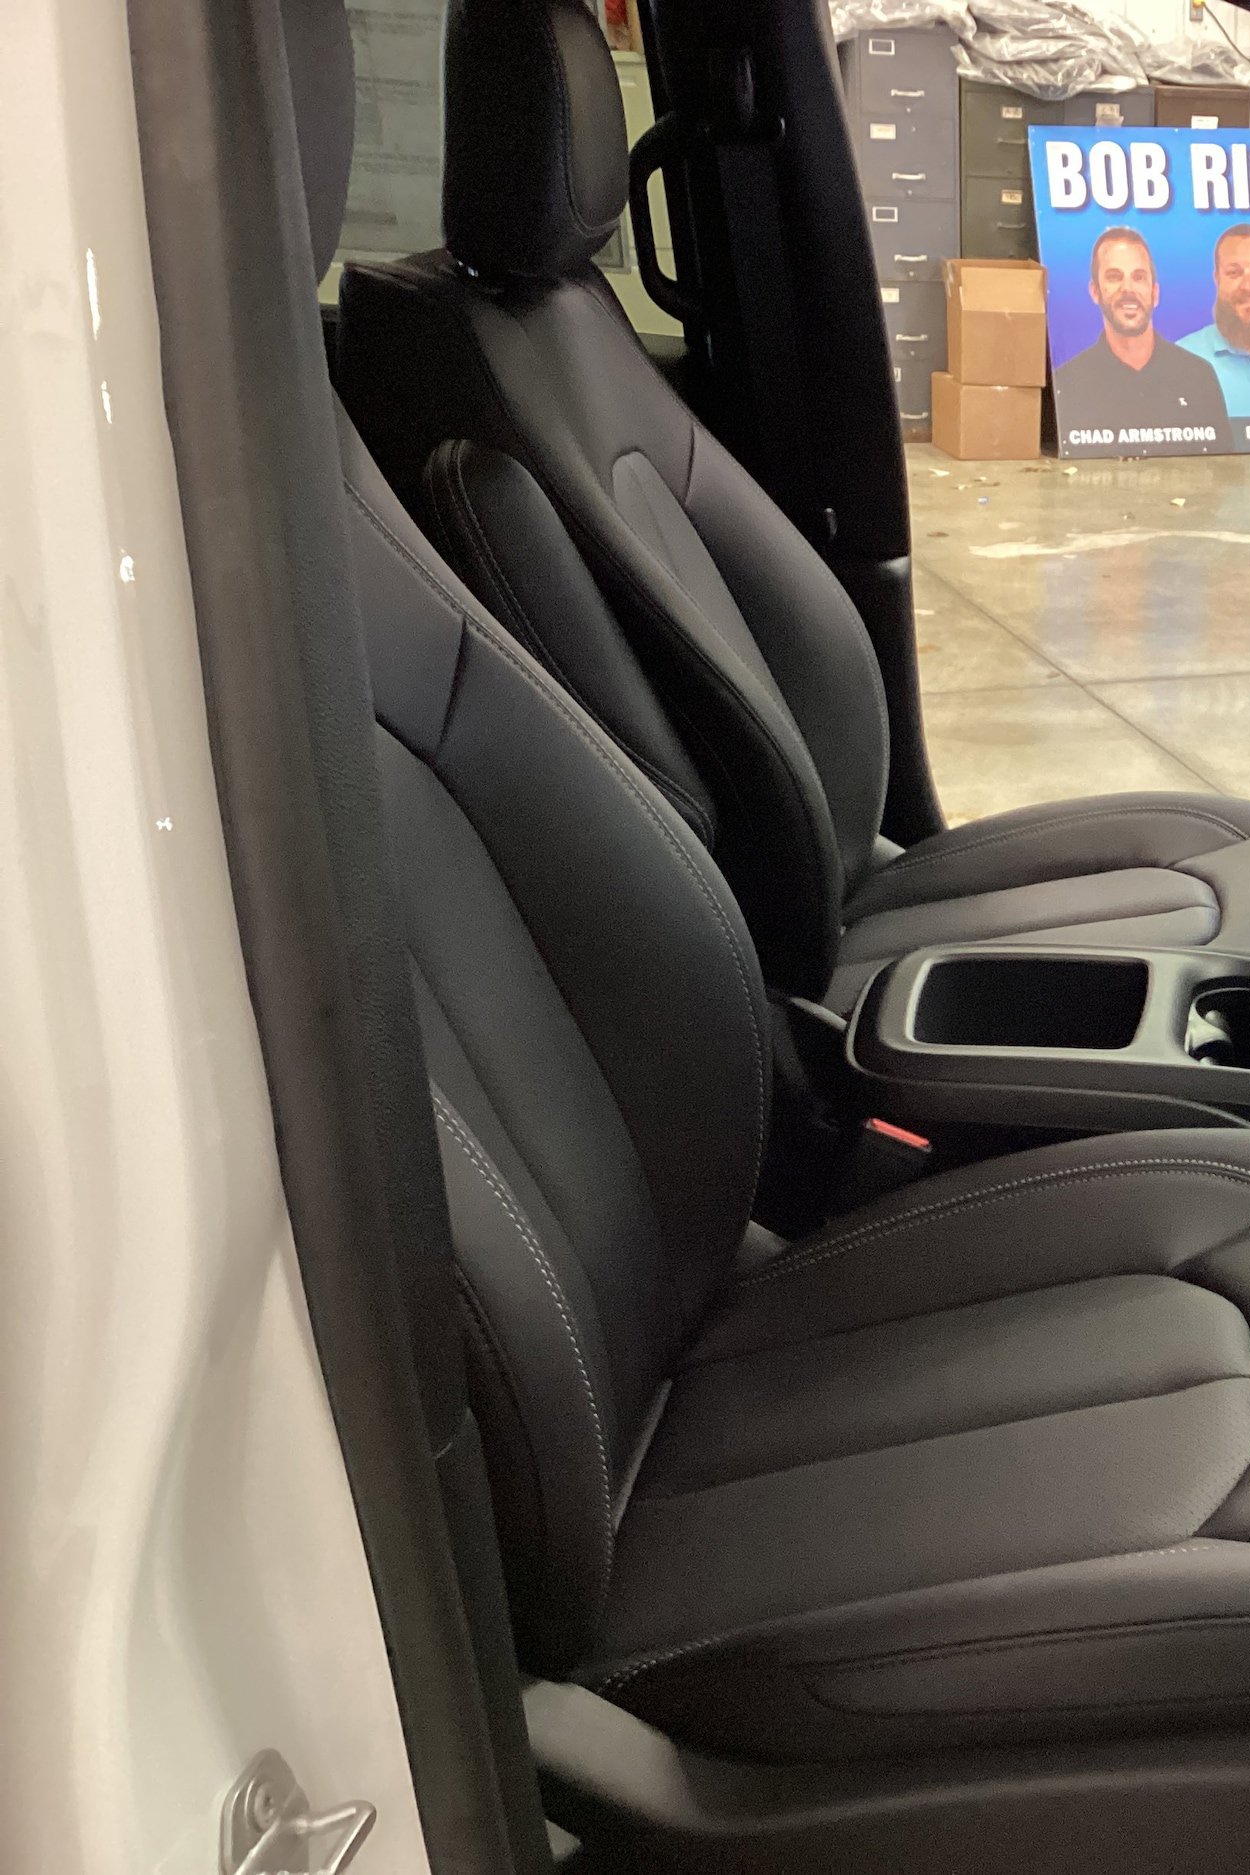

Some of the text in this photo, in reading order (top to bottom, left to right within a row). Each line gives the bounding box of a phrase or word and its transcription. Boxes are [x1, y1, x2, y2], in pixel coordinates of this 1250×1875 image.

[1046, 141, 1170, 210] BOB
[1069, 426, 1216, 445] CHAD ARMSTRONG
